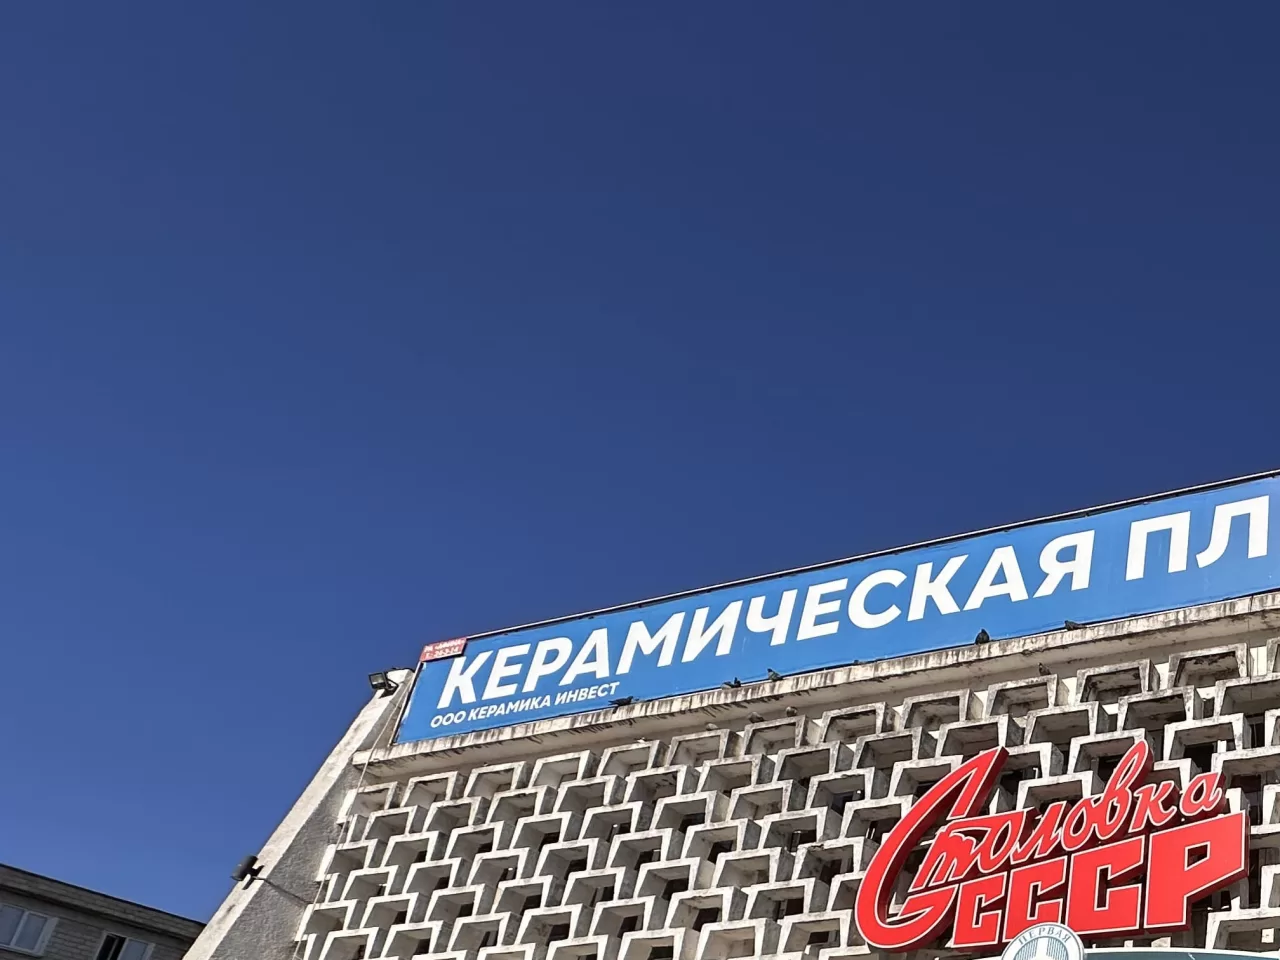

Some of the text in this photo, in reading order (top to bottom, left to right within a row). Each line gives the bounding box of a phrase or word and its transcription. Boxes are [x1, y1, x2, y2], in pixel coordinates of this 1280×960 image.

[437, 529, 1094, 709] КЕРАМИЧЕСКАЯ
[430, 681, 620, 728] ООО КЕРАМИКА ИНВЕСТ
[951, 809, 1250, 947] СССР
[1018, 926, 1071, 946] ПЕРВАЯ
